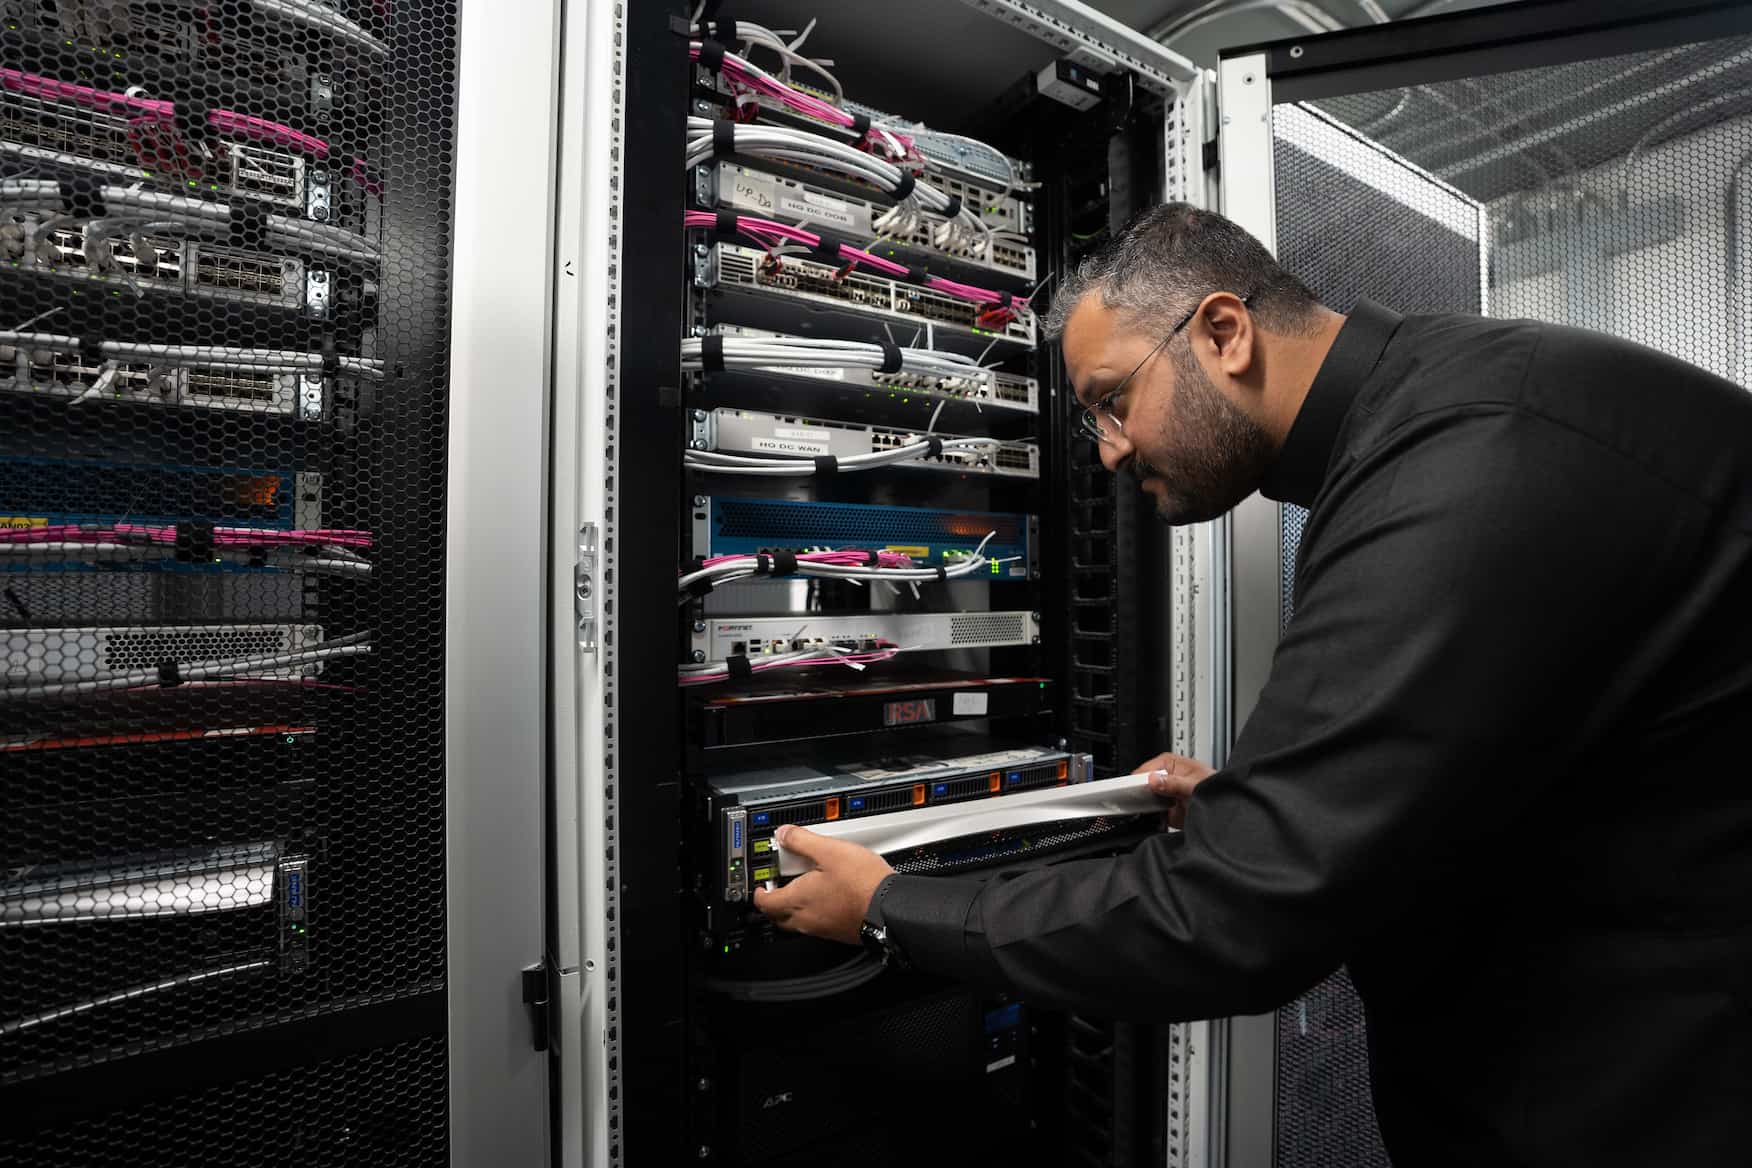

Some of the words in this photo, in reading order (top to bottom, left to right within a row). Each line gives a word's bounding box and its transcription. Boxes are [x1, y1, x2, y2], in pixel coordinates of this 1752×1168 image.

[779, 442, 794, 450] DC
[799, 445, 821, 453] WAN
[762, 1091, 793, 1109] APC
